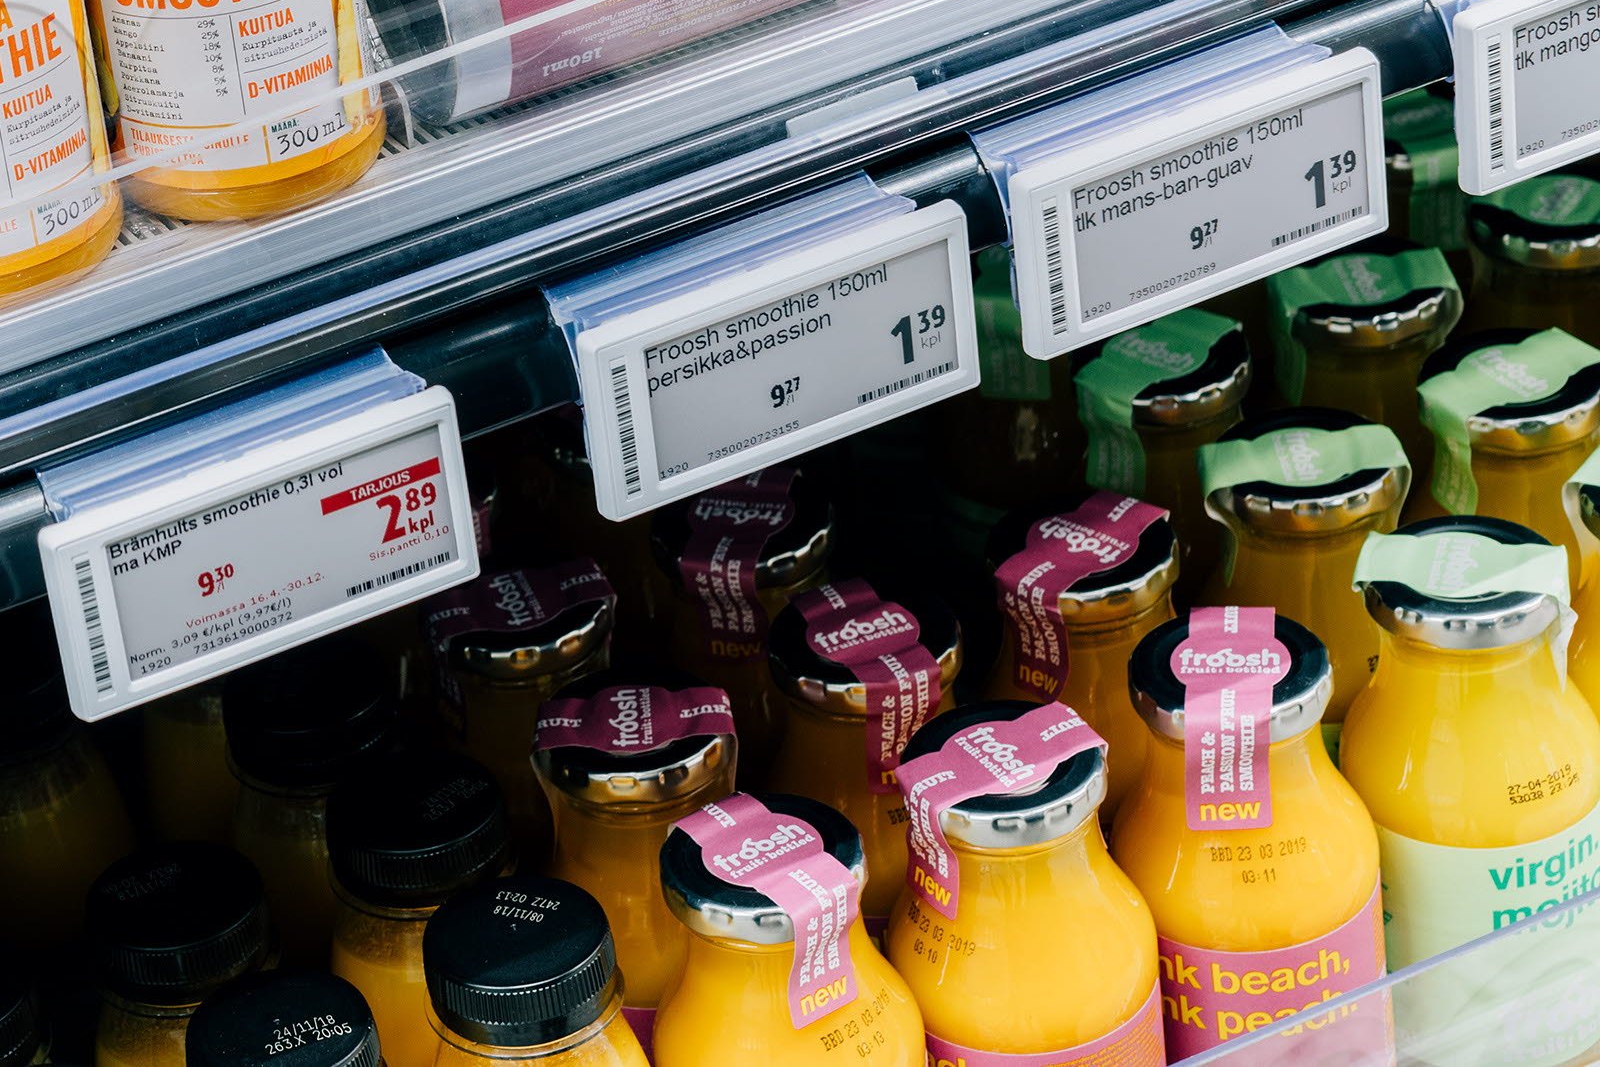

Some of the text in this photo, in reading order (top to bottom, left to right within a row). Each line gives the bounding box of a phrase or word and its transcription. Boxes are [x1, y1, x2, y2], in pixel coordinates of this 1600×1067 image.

[112, 16, 215, 29] Ananas 29%
[113, 26, 219, 39] Mango 25%
[238, 8, 294, 37] KUITUA
[1515, 10, 1580, 47] Froosh
[115, 38, 165, 53] Appelsiini
[117, 49, 153, 62] Banaani
[119, 61, 158, 75] Kurpitsa
[121, 72, 161, 85] Porkkana
[248, 54, 333, 99] D-VITAMIINIA
[2, 84, 53, 120] KUITUA
[123, 84, 184, 99] Acerolamarja
[125, 94, 180, 109] Sitruskuitu
[127, 105, 183, 121] D-vitamiini
[13, 128, 87, 182] D-VITAMIINIA
[278, 127, 319, 154] 300
[1520, 139, 1544, 155] 1920
[1074, 109, 1303, 208] Froosh smoothie 150ml
[1102, 153, 1254, 225] mans-ban-guav
[1332, 178, 1352, 195] kpl
[44, 207, 79, 234] 300
[1084, 262, 1216, 318] 1920 7350020720789
[646, 264, 889, 369] Froosh smoothie 150ml
[648, 310, 832, 398] persikka&passion
[921, 333, 942, 350] kpl
[659, 420, 800, 478] 1920 7350020723155
[349, 470, 411, 502] TARJOUS
[110, 462, 344, 559] Brämhults smoothie voi
[409, 512, 435, 536] kpl
[424, 525, 450, 542] 0,10
[113, 540, 182, 577] ma KMP
[186, 600, 247, 630] Voimassa
[140, 611, 293, 675] 1920 7313619000372
[815, 611, 907, 649] froosh
[129, 632, 199, 665] Norm. 3,09
[711, 640, 760, 658] new
[1179, 648, 1280, 668] froosh
[1019, 665, 1058, 694] new
[1226, 666, 1281, 674] bottled
[609, 689, 639, 747] froosh
[881, 713, 895, 761] PEACH
[968, 727, 1036, 781] froosh
[1221, 732, 1235, 793] PASSION
[1240, 715, 1254, 792] SMOOTHIE
[1201, 746, 1216, 794] PEACH
[1508, 764, 1571, 795] 27-04-2019
[1201, 802, 1261, 822] new
[713, 823, 806, 872] froosh
[770, 834, 815, 860] bottled
[1211, 836, 1306, 862] BBD 23 03 2019
[915, 866, 952, 907] new
[1242, 868, 1276, 884] 03:11
[493, 905, 544, 923] 08/11/18
[949, 934, 976, 956] 2019
[1211, 949, 1350, 995] beach,
[800, 976, 847, 1016] new
[274, 1014, 336, 1041] 24/11/18
[313, 1023, 353, 1041] 20:05
[821, 1029, 844, 1052] BBD
[858, 1031, 885, 1058] 03:13
